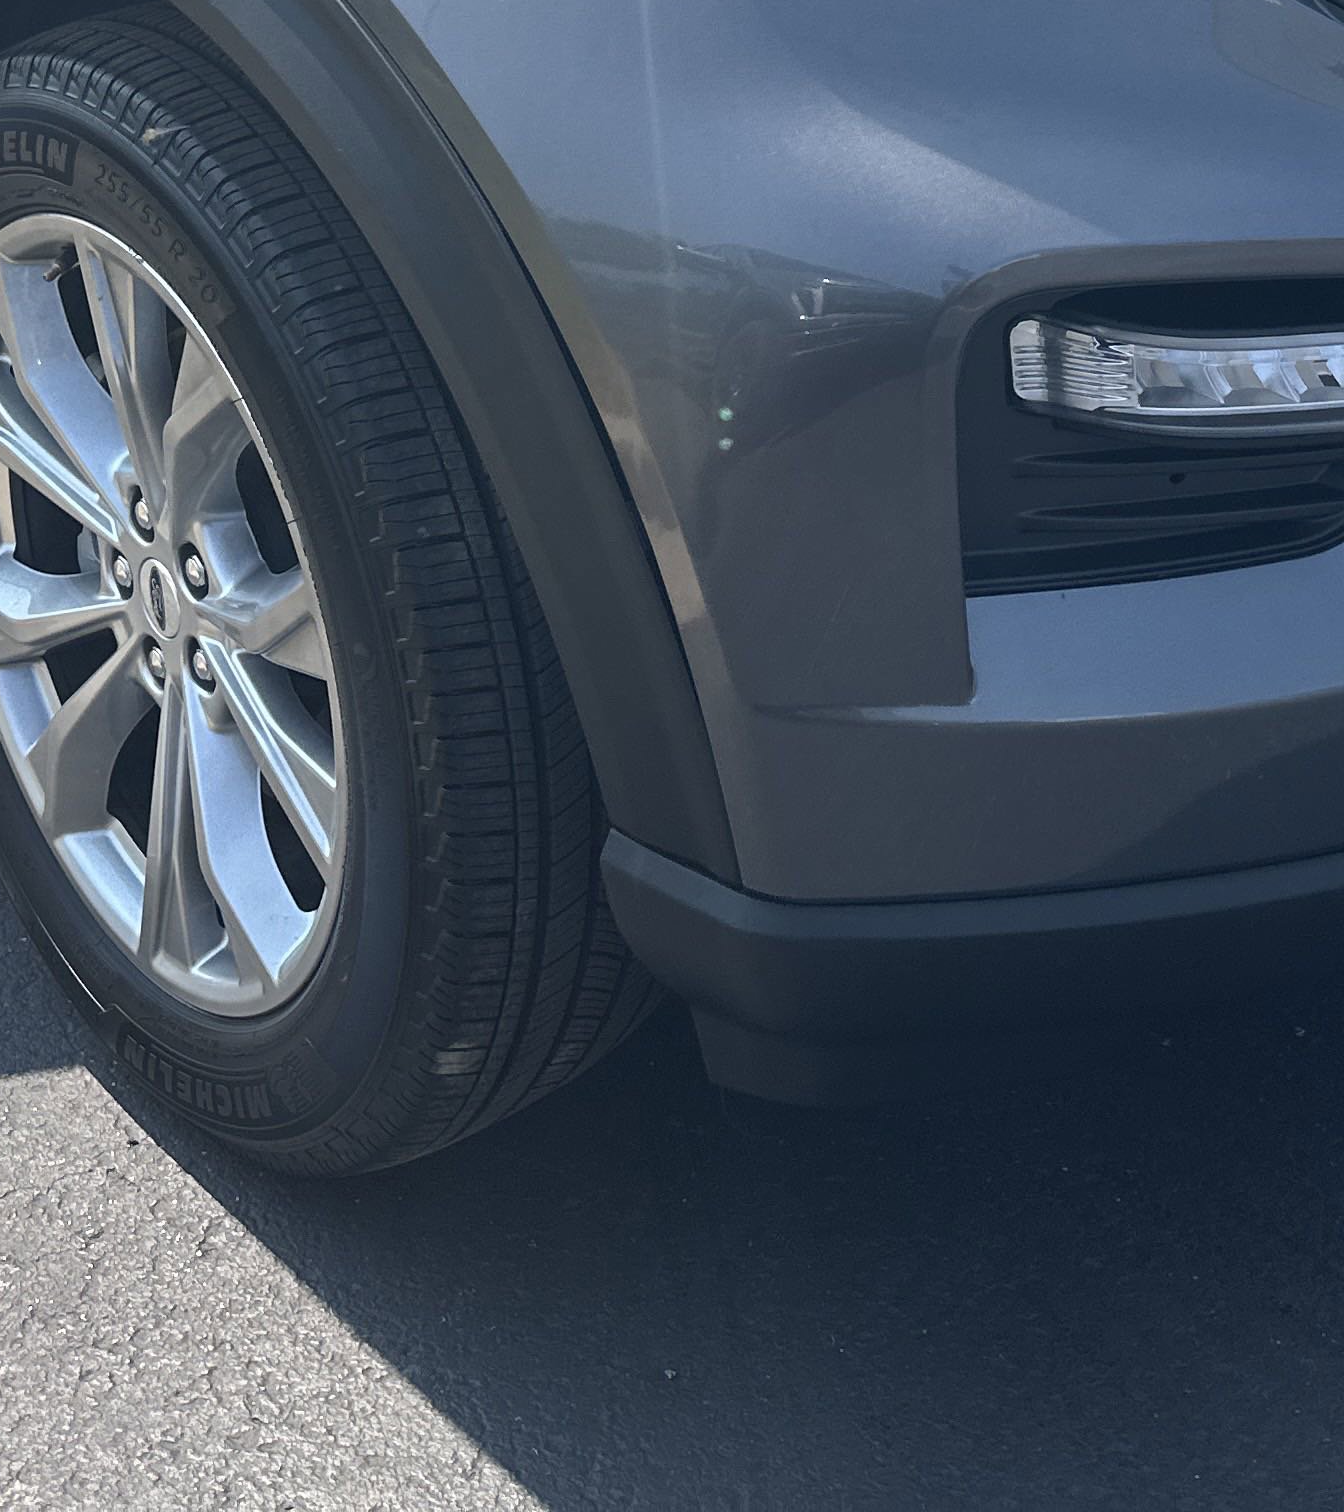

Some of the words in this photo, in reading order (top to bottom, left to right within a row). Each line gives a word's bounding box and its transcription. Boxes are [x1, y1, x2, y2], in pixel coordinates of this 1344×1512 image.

[93, 163, 163, 236] 255/55
[167, 239, 186, 262] R
[188, 266, 217, 304] 20
[124, 1034, 273, 1119] MICHELIN
